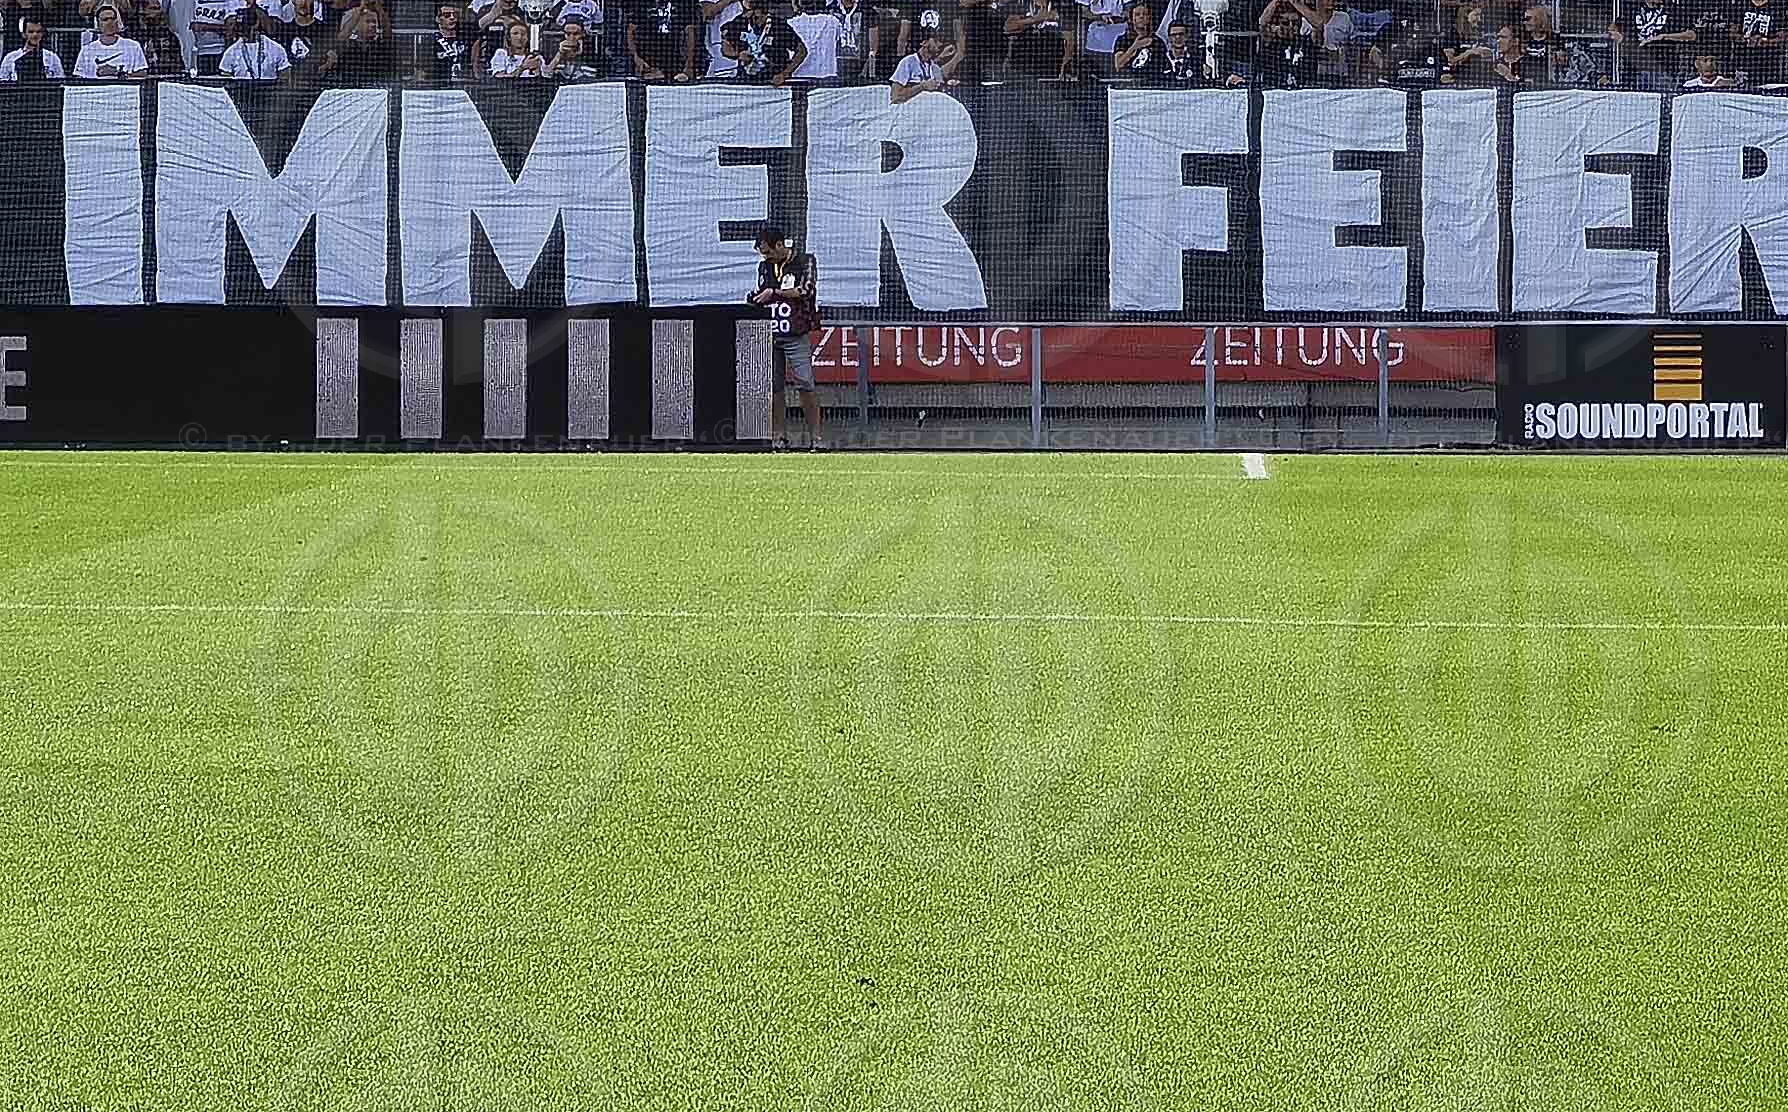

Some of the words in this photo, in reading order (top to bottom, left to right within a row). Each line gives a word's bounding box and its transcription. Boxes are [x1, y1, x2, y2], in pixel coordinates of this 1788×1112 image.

[62, 80, 989, 312] IMMER
[810, 325, 1023, 368] ZEITUNG
[1190, 325, 1405, 368] ZEITUNG
[1535, 402, 1763, 439] SOUNDPORTAL
